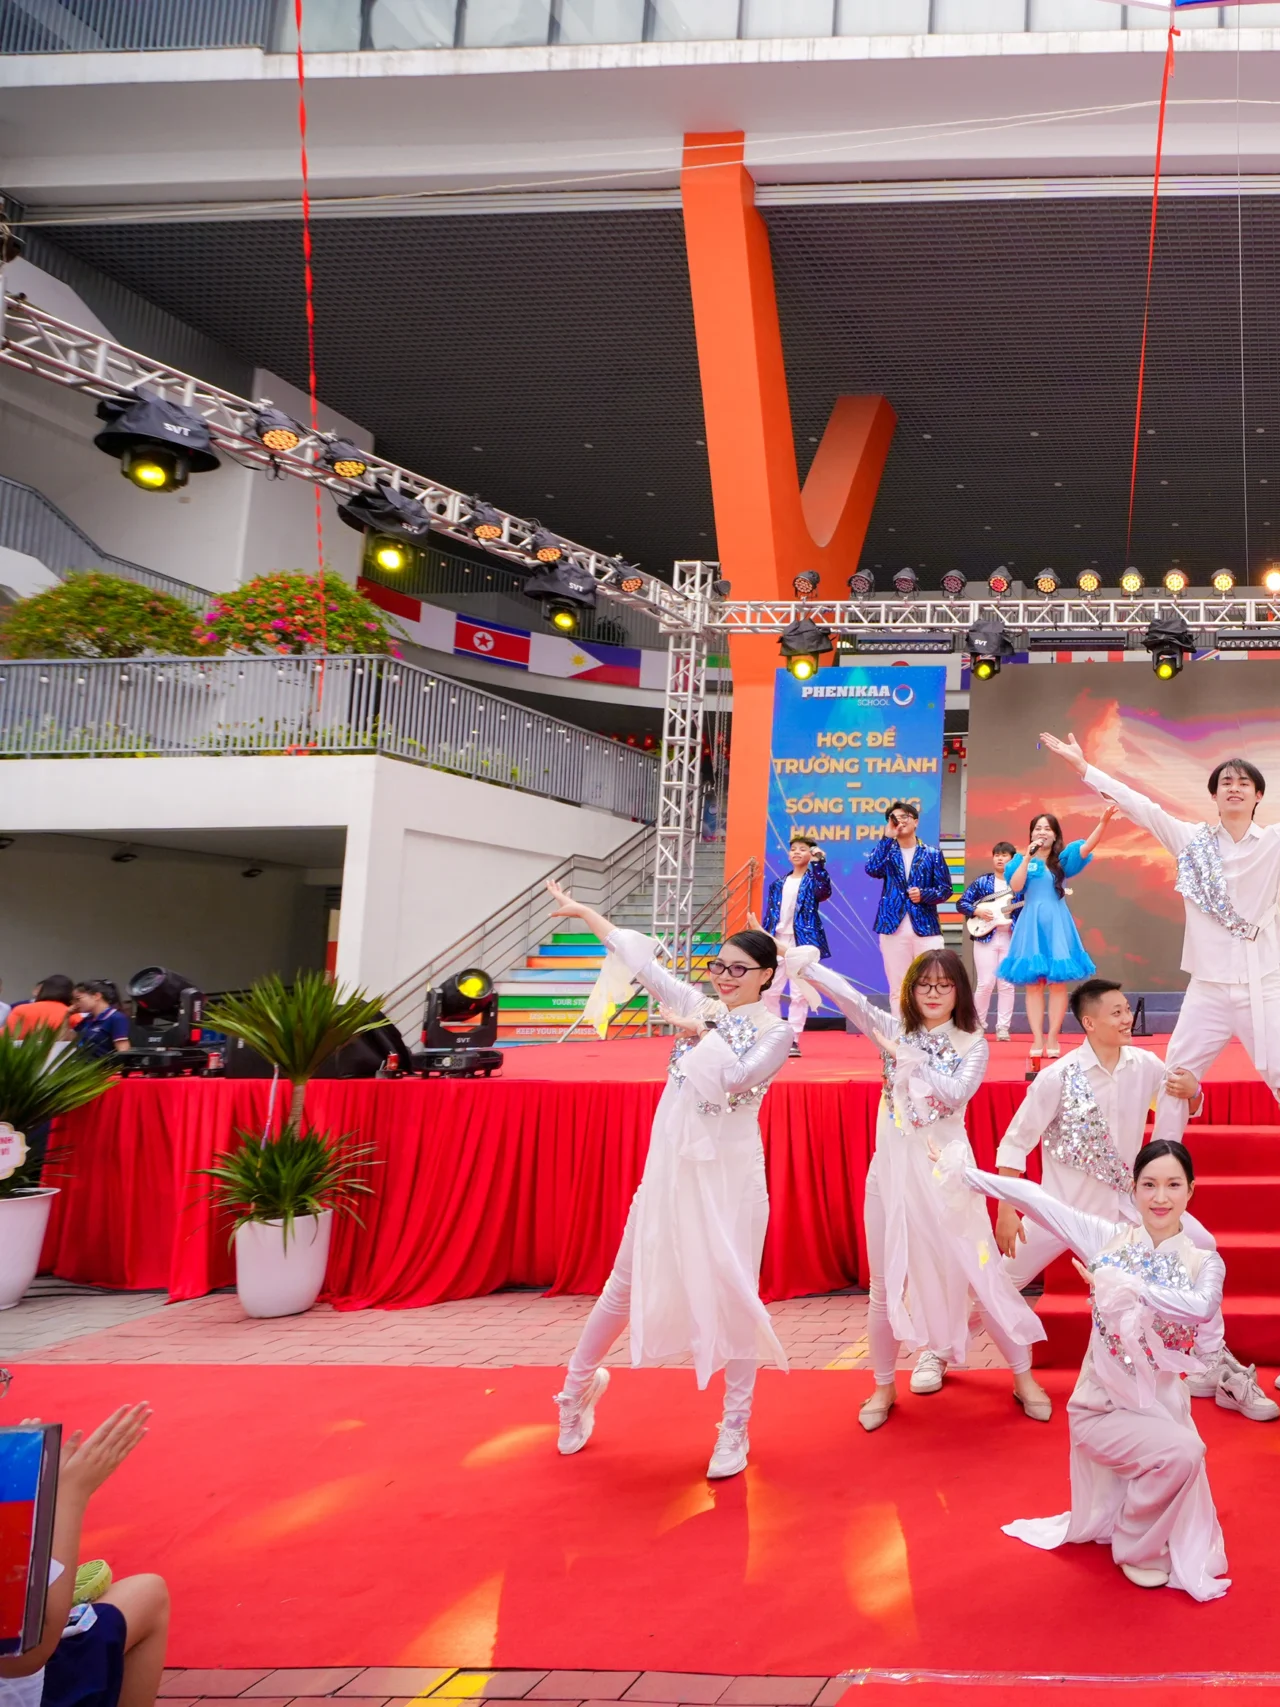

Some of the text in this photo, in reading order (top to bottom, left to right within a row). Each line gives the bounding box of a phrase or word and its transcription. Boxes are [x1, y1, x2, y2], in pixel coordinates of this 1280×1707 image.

[163, 422, 191, 437] SVT
[569, 582, 583, 592] SVT
[801, 685, 891, 698] PHENIKAA
[816, 726, 897, 751] HỌC ĐỂ
[774, 753, 938, 774] TRƯỞNG THÀNH
[785, 792, 922, 814] SỐNG TROG
[552, 998, 572, 1006] YOUR
[516, 1027, 535, 1035] KEEP
[536, 1027, 557, 1035] YOUR
